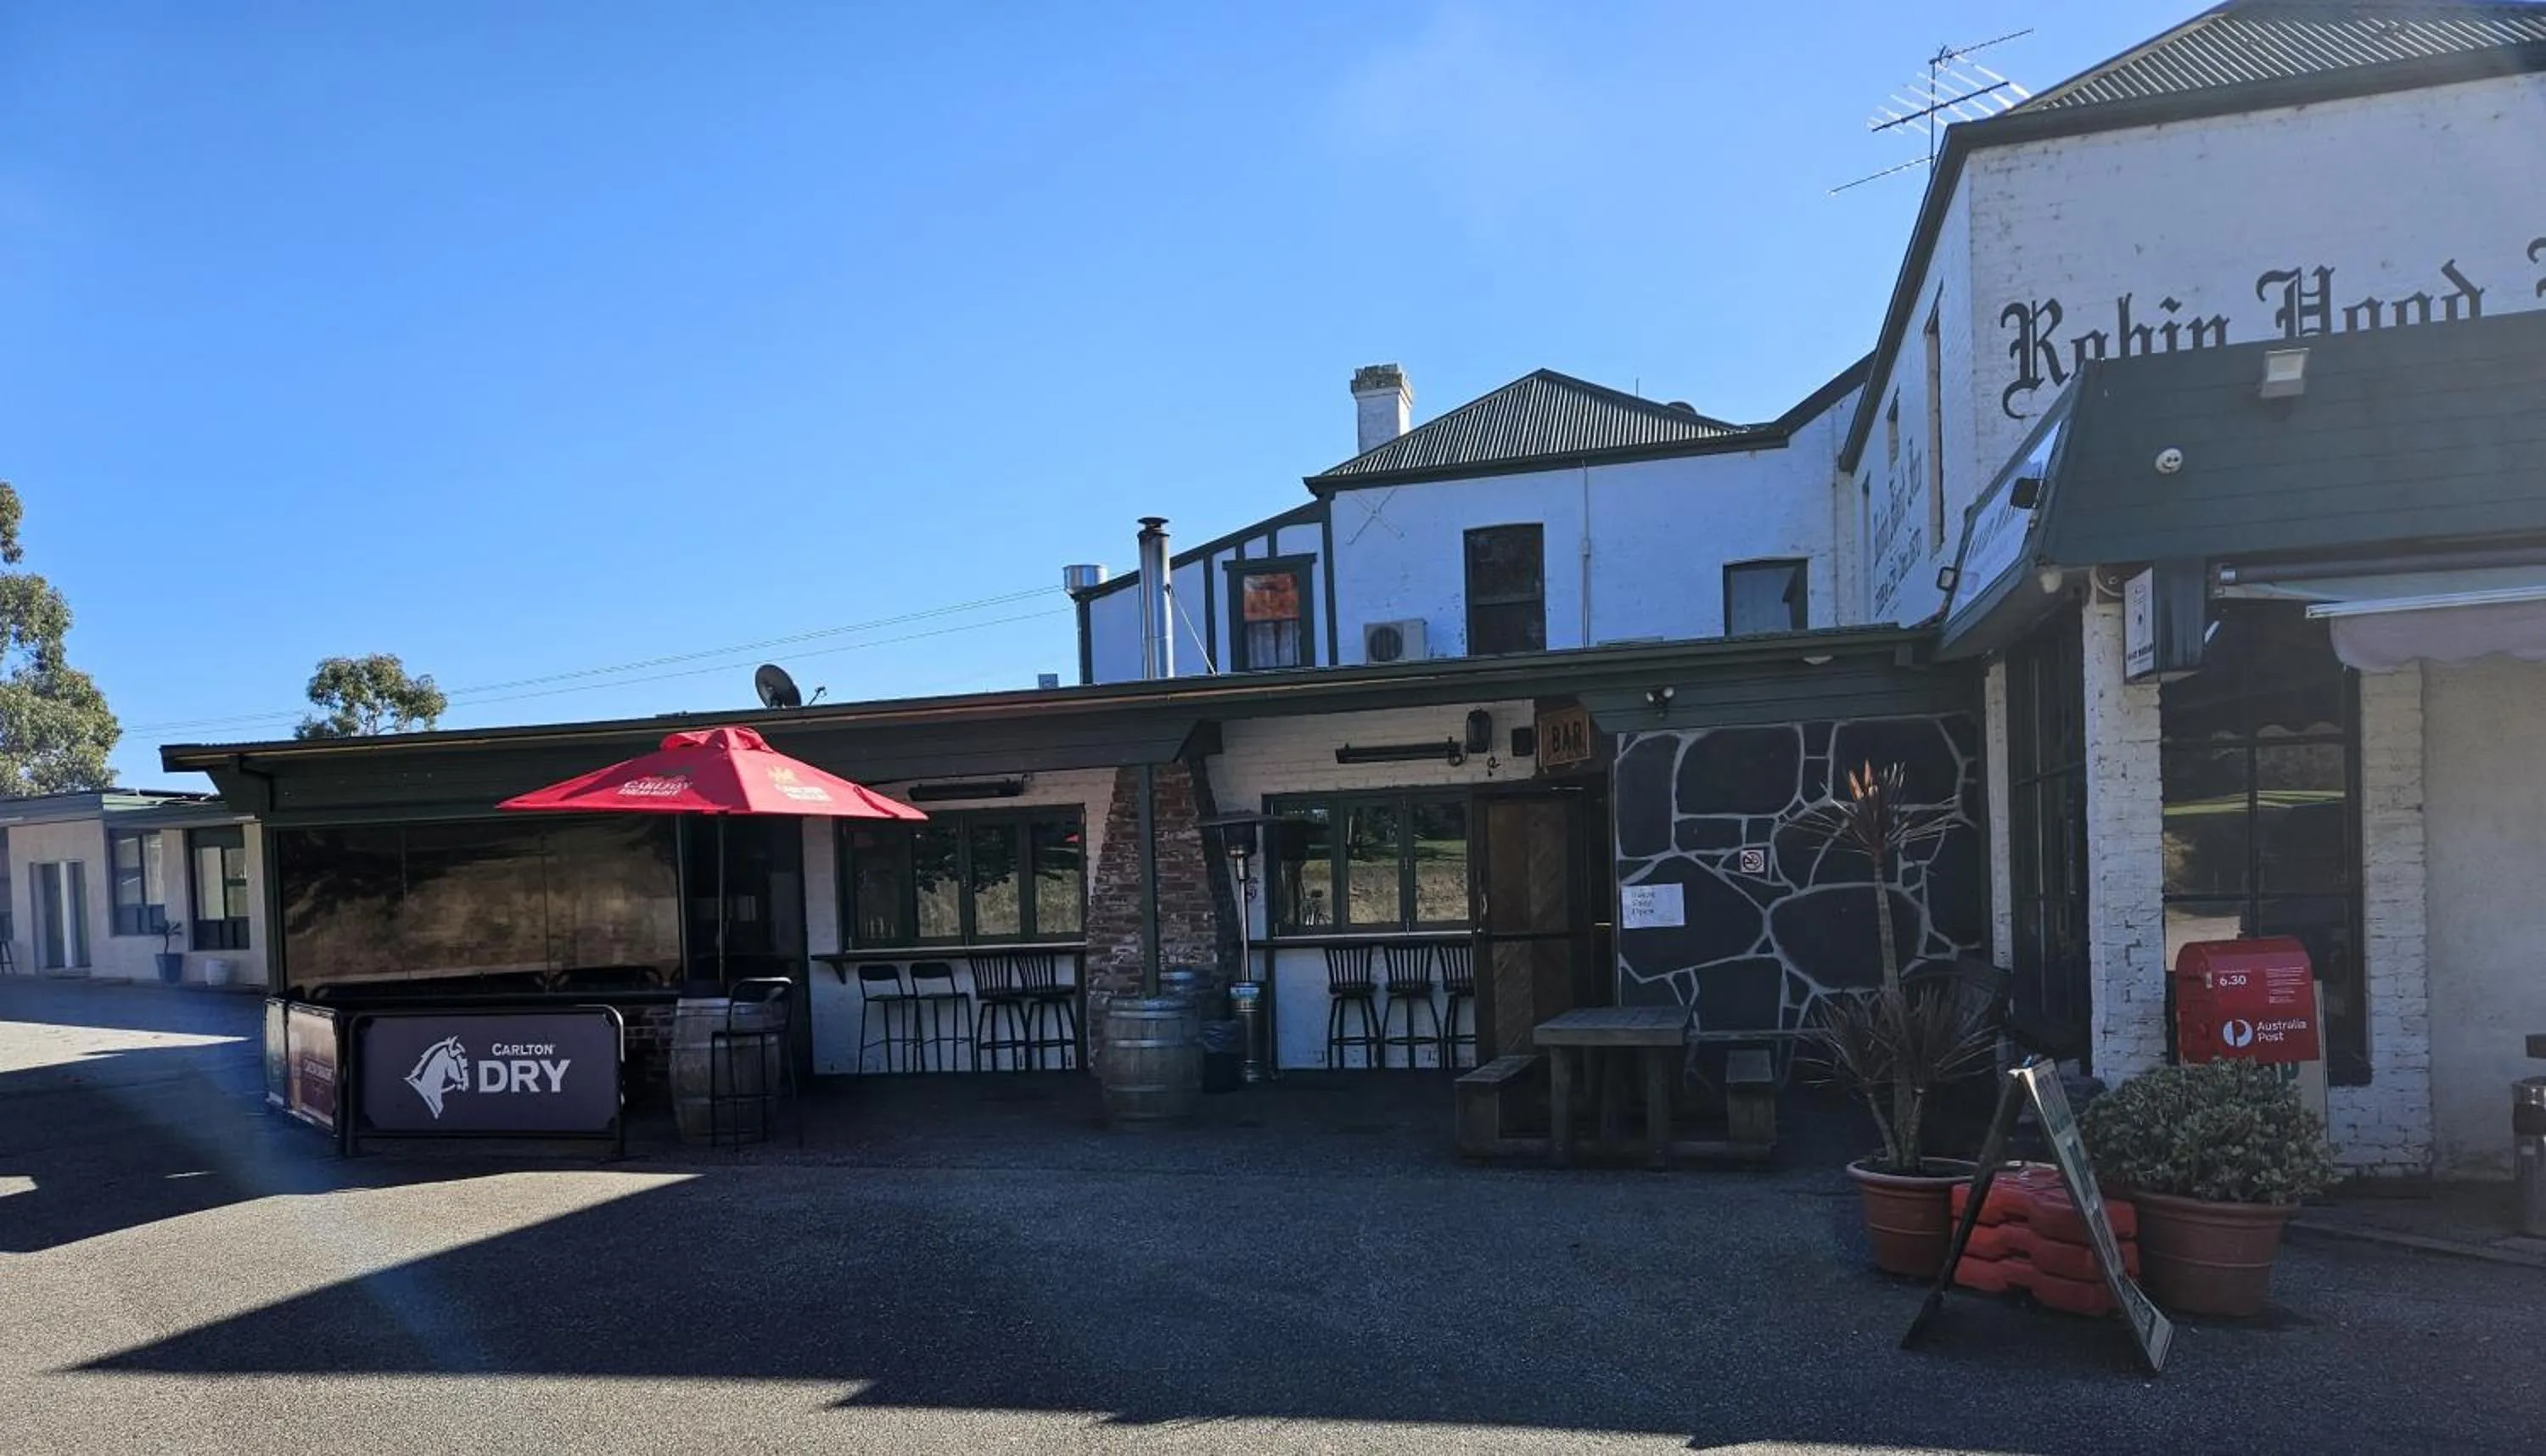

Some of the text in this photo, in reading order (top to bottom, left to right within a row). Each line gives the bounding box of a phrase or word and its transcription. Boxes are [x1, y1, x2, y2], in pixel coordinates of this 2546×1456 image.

[1552, 720, 1581, 753] BAR
[2219, 975, 2246, 987] 6.30
[2257, 1018, 2308, 1032] Australia
[2257, 1030, 2285, 1043] Post
[491, 1043, 555, 1056] CARLTON
[478, 1058, 571, 1094] DRY
